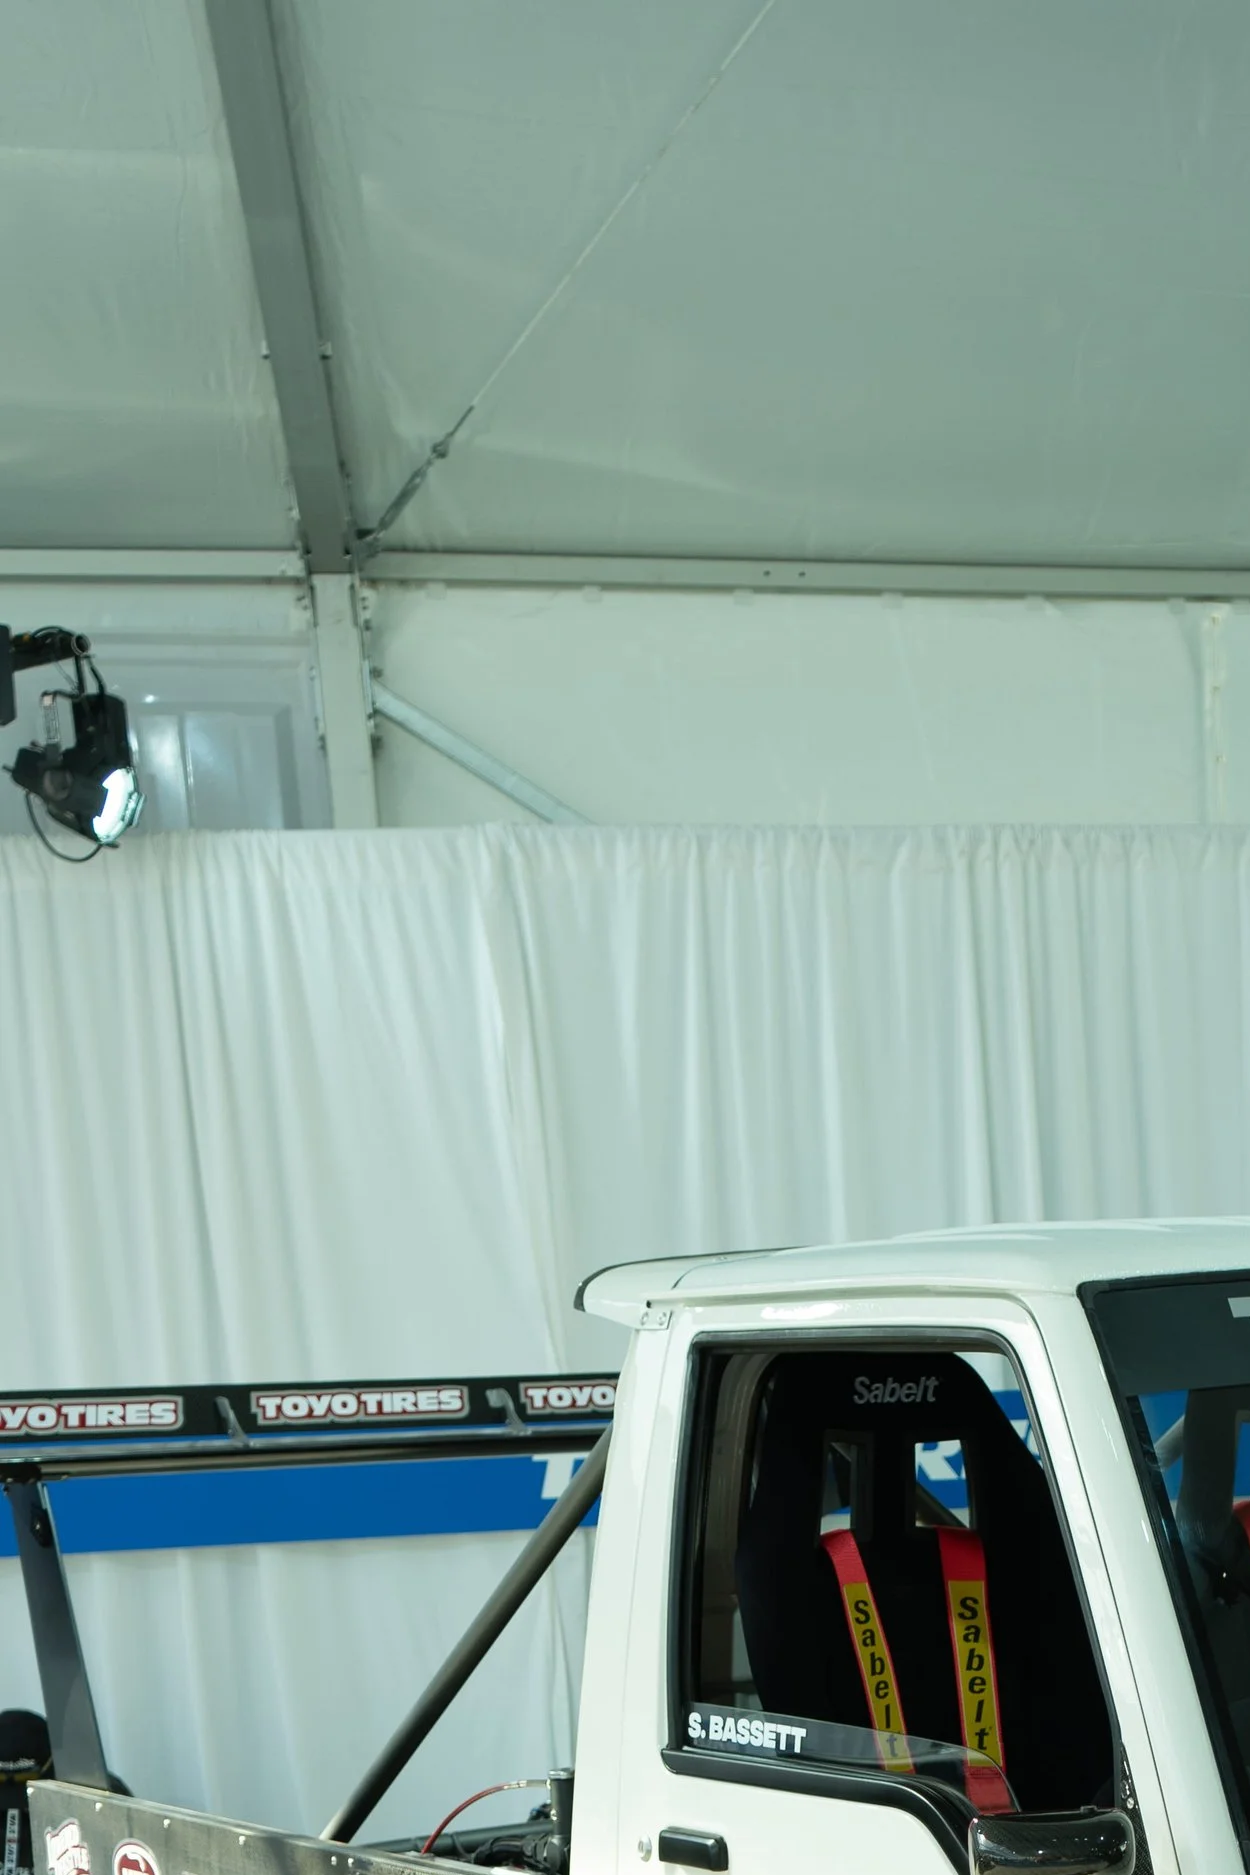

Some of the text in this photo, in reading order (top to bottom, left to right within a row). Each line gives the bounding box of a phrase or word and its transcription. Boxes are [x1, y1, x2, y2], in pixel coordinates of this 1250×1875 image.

[259, 1389, 462, 1420] TOYO TIRES
[526, 1383, 616, 1409] TOYO
[853, 1376, 939, 1405] Sabelt
[61, 1402, 177, 1429] TIRES
[853, 1600, 900, 1758] Sabelt
[956, 1596, 991, 1752] Sabelt
[688, 1712, 807, 1754] S. BASSETT
